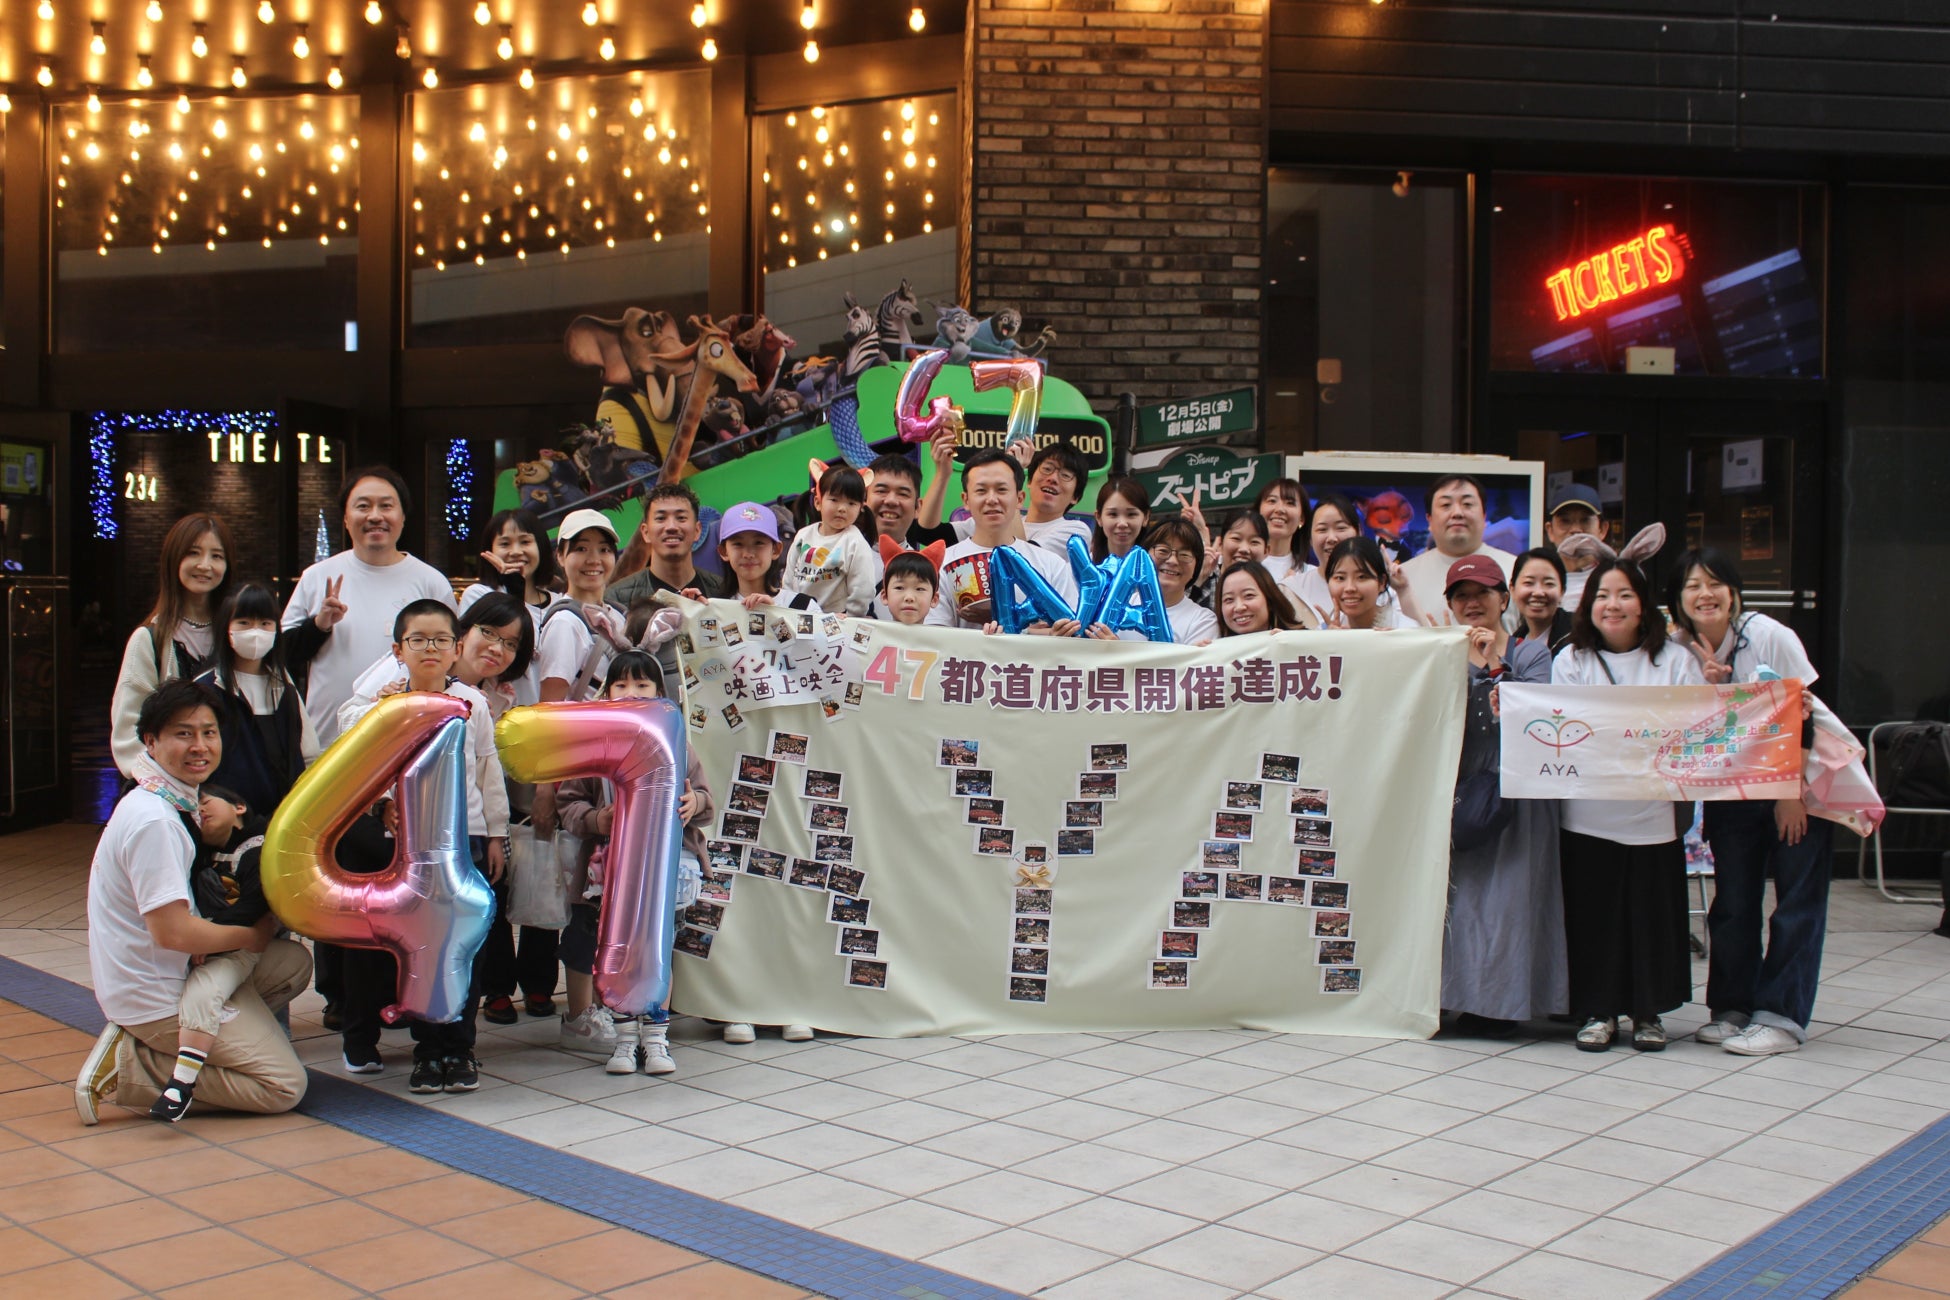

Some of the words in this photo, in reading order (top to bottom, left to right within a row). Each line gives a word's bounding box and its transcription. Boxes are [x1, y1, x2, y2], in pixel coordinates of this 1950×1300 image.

[1545, 226, 1674, 321] TICKETS
[893, 348, 1045, 450] 47
[1158, 399, 1234, 422] 12月5日(金)
[1167, 415, 1222, 437] 劇場公開
[1069, 435, 1104, 454] 100
[1185, 453, 1220, 467] Disney
[124, 471, 158, 502] 234
[1150, 458, 1259, 508] ズートピア
[989, 534, 1174, 642] AYA
[703, 664, 727, 677] AYA
[724, 663, 844, 701] 映画上映会
[864, 645, 1344, 713] 47都道府県開催達成!
[1540, 763, 1579, 777] AYA
[261, 691, 688, 1023] 47
